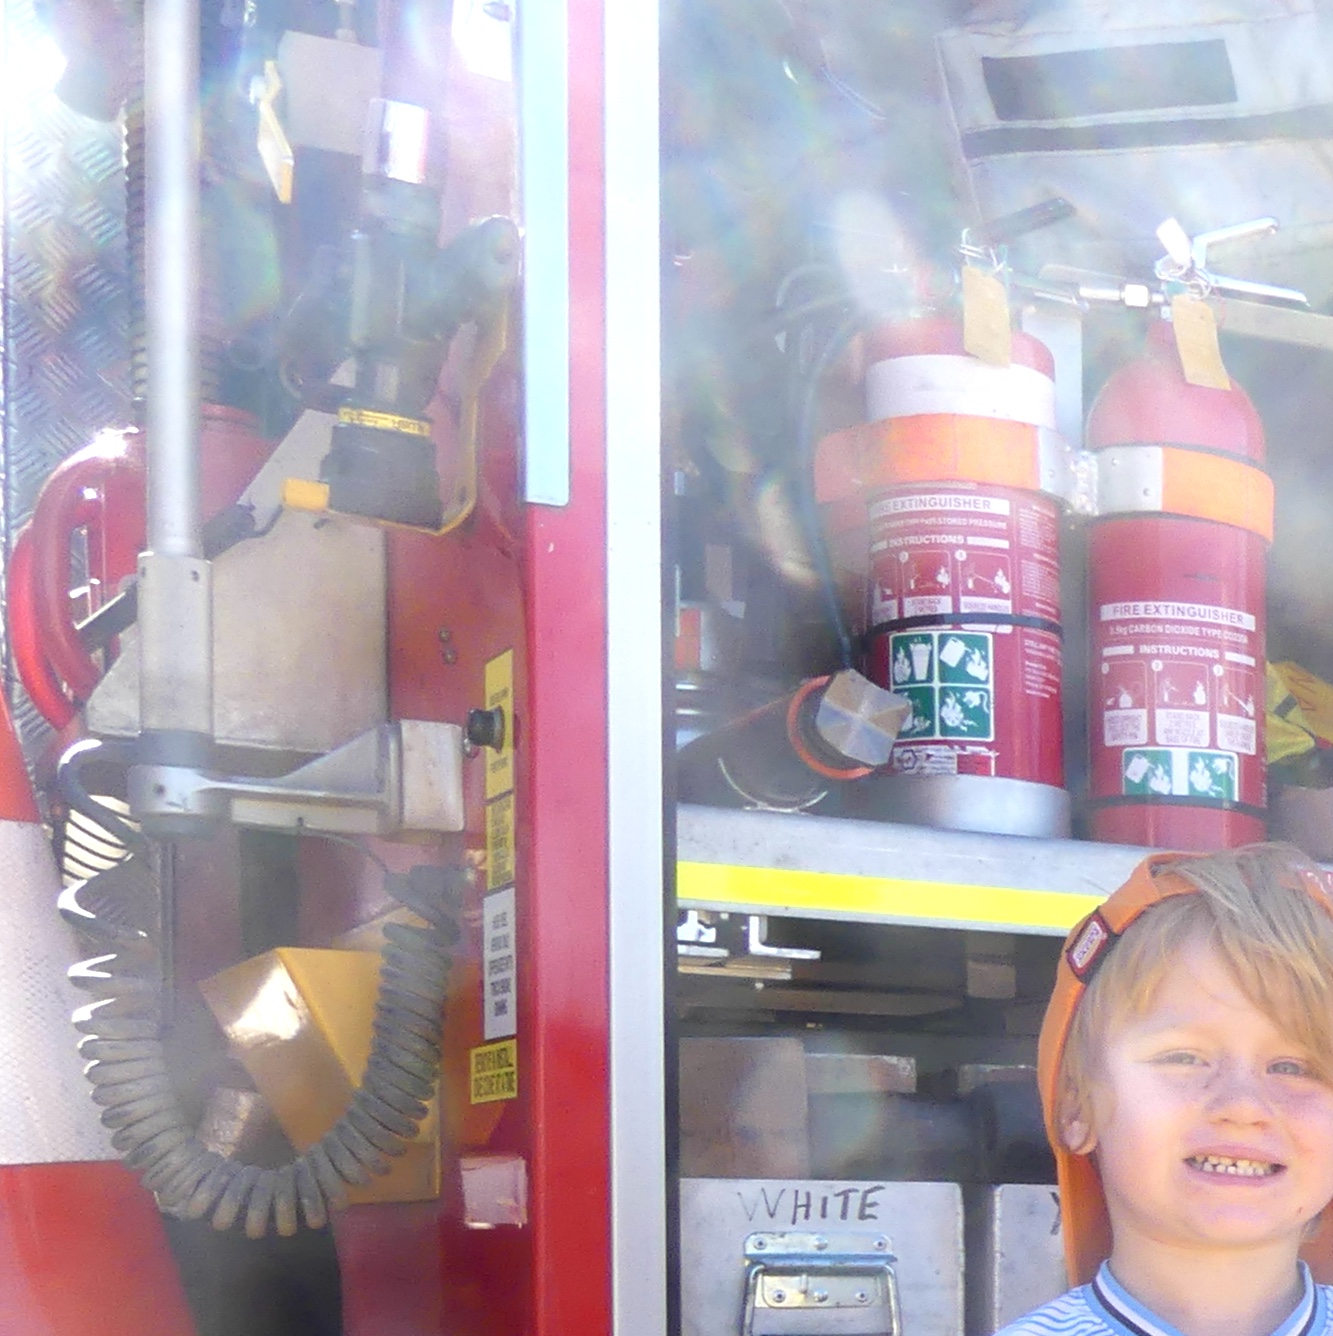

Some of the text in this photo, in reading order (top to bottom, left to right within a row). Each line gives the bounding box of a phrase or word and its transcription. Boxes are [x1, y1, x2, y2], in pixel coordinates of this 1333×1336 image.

[893, 496, 992, 511] EXTINGUISHER
[888, 534, 965, 548] INSTRUCTIONS
[1112, 603, 1245, 624] FIRE EXTINGUISHER
[1129, 623, 1164, 635] CARBON
[1165, 625, 1201, 637] DIOXIDE
[1138, 643, 1221, 659] INSTRUCTIONS
[736, 1184, 887, 1226] WHITE
